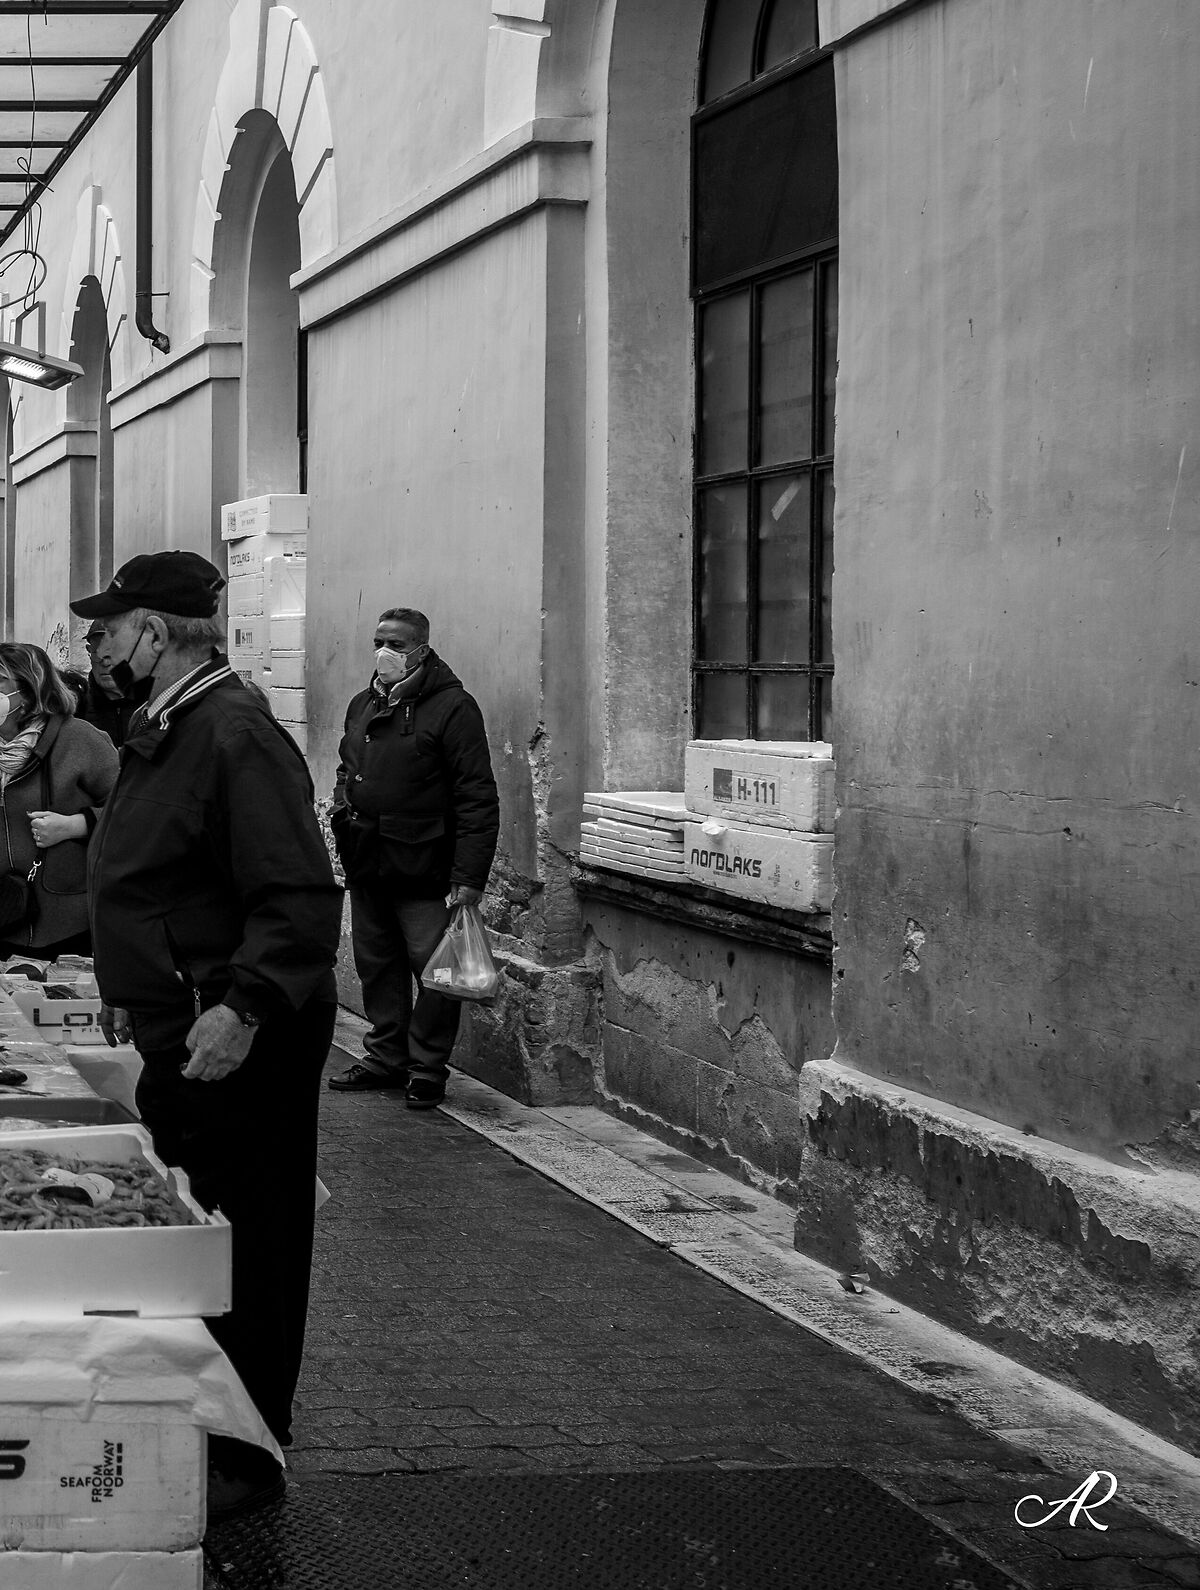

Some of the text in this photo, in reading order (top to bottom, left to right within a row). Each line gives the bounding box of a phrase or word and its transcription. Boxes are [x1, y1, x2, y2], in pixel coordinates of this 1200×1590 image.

[737, 777, 776, 805] H-111
[60, 1476, 124, 1488] SEAFOOD
[91, 1464, 103, 1503] FROM
[103, 1439, 115, 1498] NORWAY
